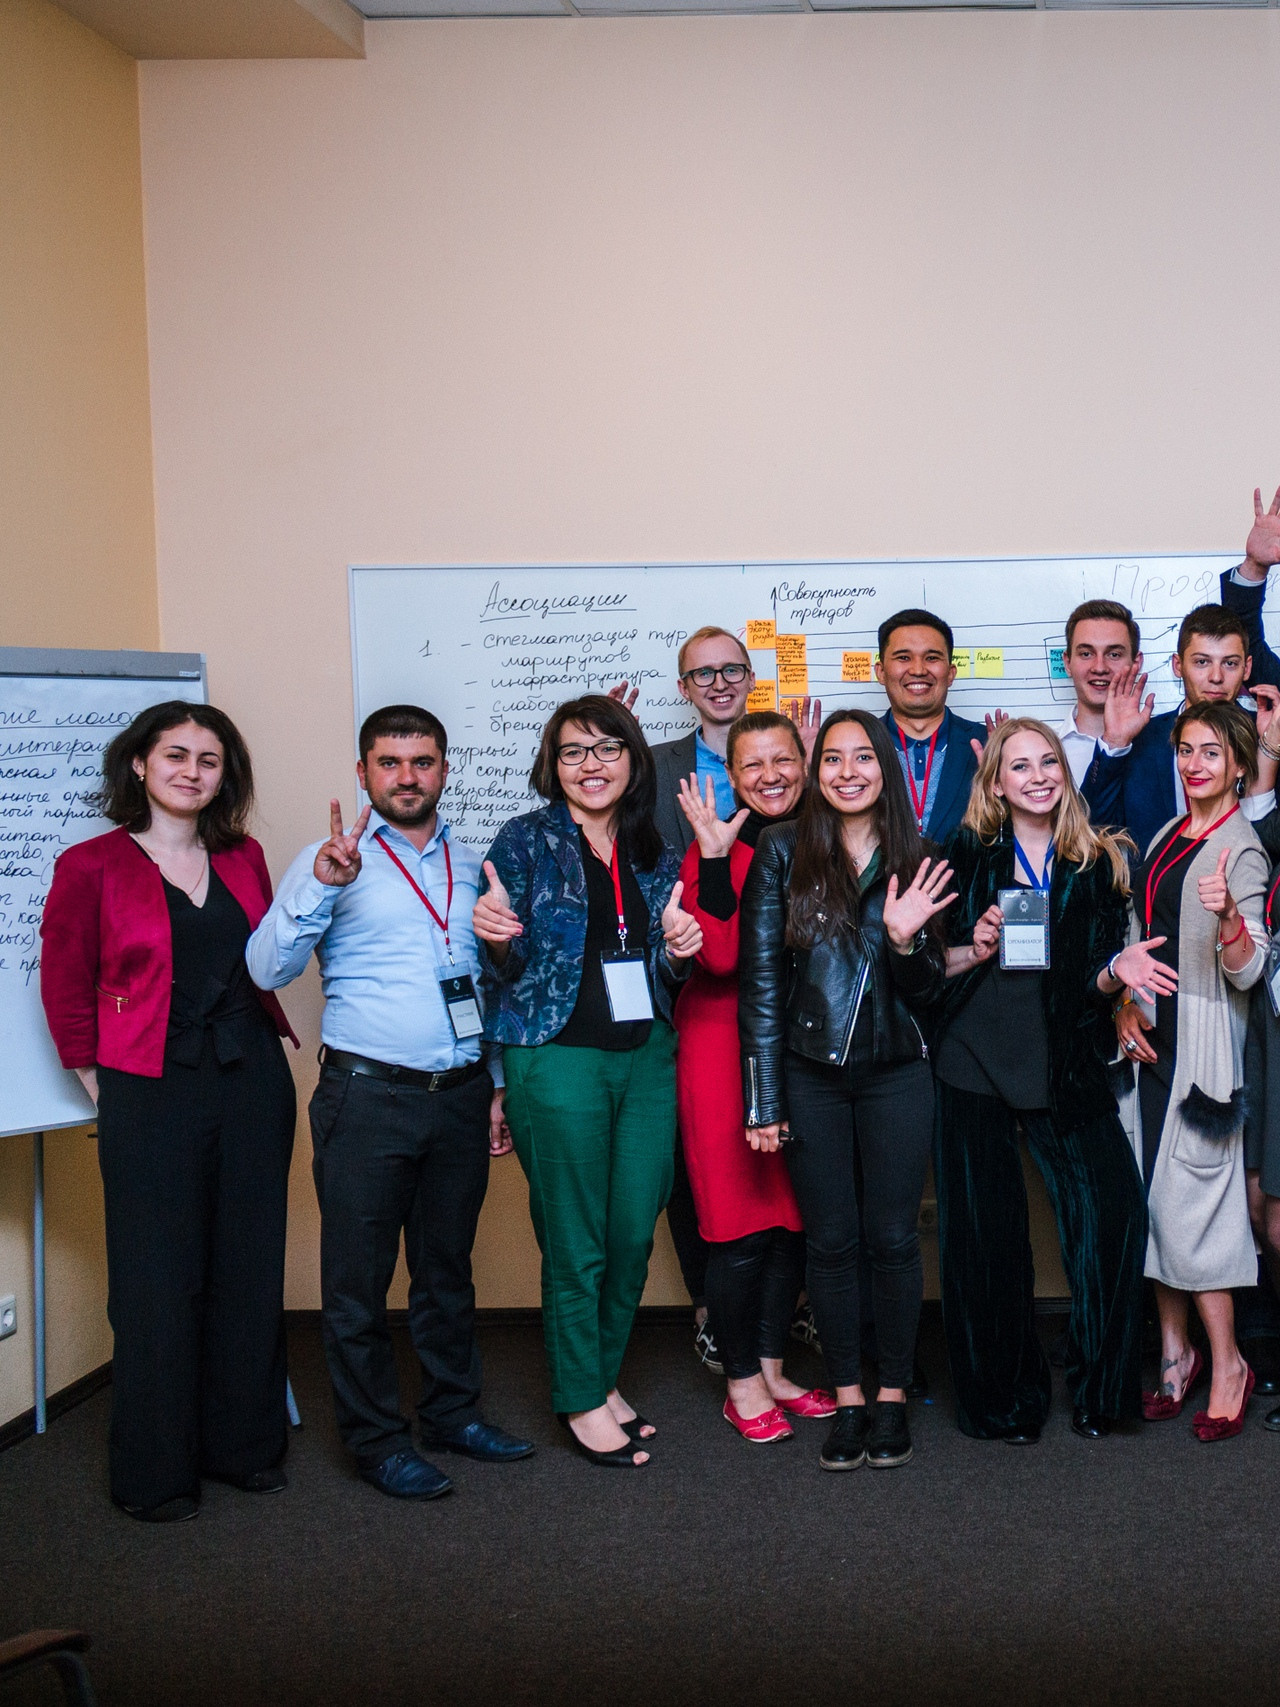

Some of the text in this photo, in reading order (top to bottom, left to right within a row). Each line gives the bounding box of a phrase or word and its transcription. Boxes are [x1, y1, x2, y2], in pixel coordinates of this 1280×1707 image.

[480, 580, 628, 619] Ассоциации
[778, 581, 877, 607] Совокупность
[790, 600, 855, 626] трендов
[501, 645, 631, 676] маршрутов
[491, 668, 667, 690] инфраструктура
